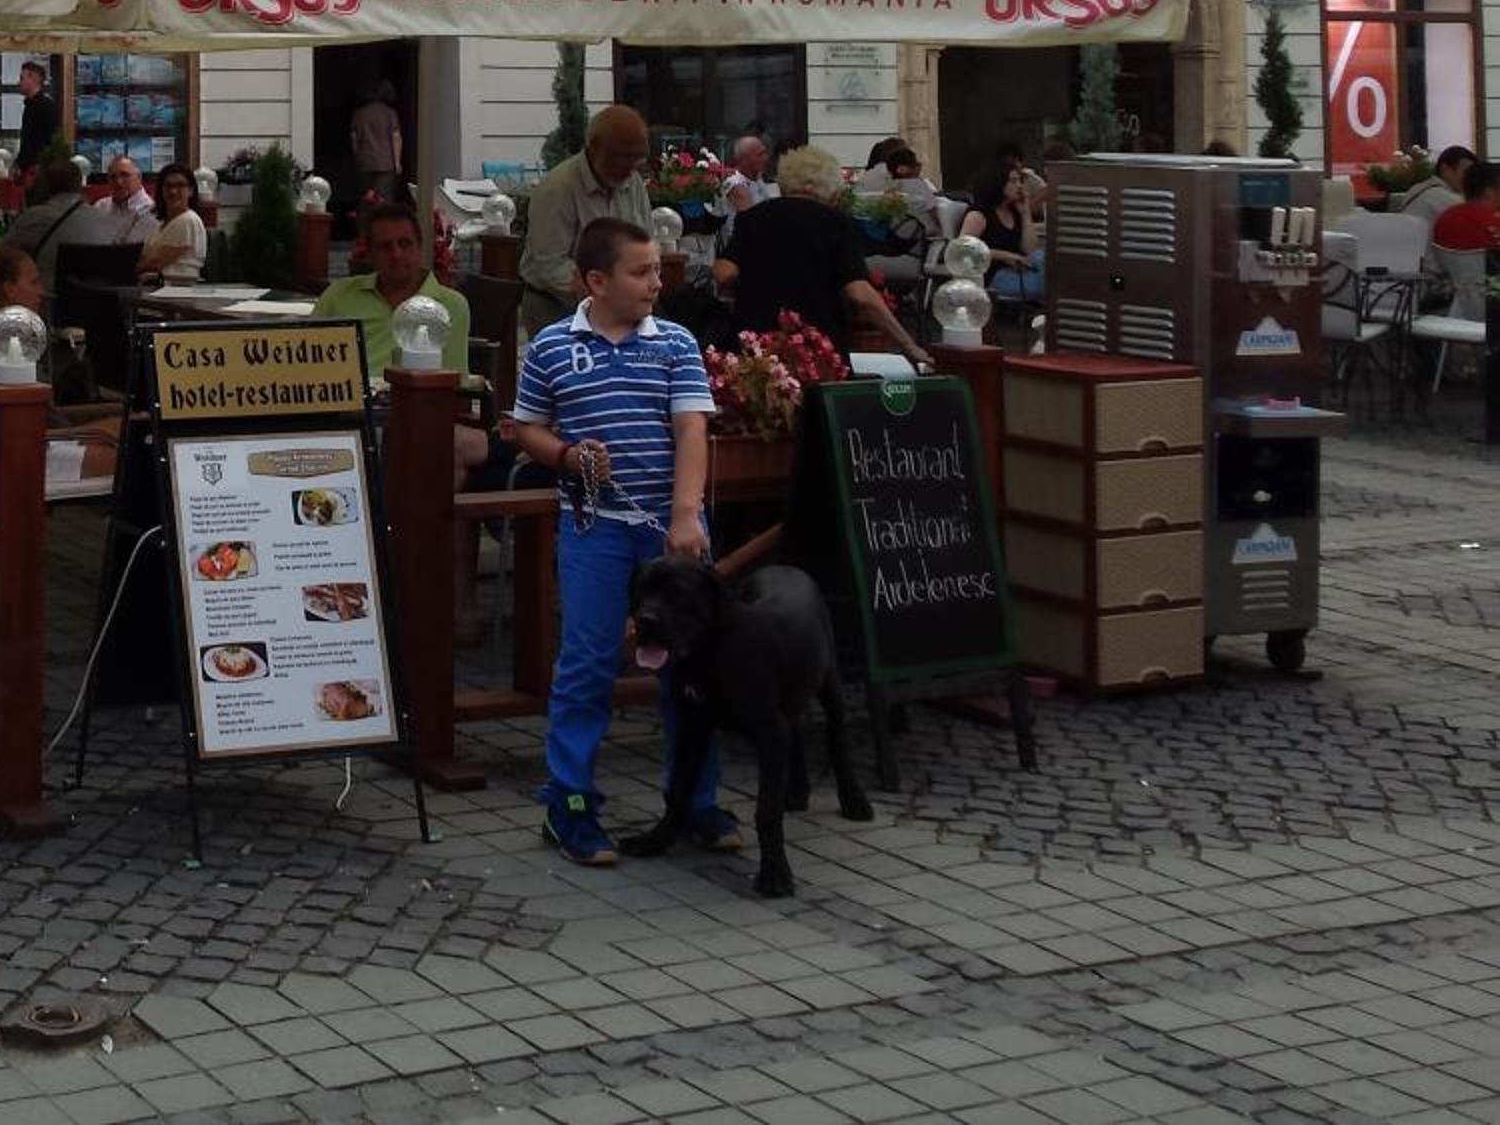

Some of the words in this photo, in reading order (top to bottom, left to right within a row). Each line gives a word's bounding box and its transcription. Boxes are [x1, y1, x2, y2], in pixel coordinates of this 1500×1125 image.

[163, 341, 227, 369] Casa
[242, 337, 350, 366] Weidner
[169, 378, 355, 411] hotel-restaurant
[847, 421, 966, 484] Restaurant
